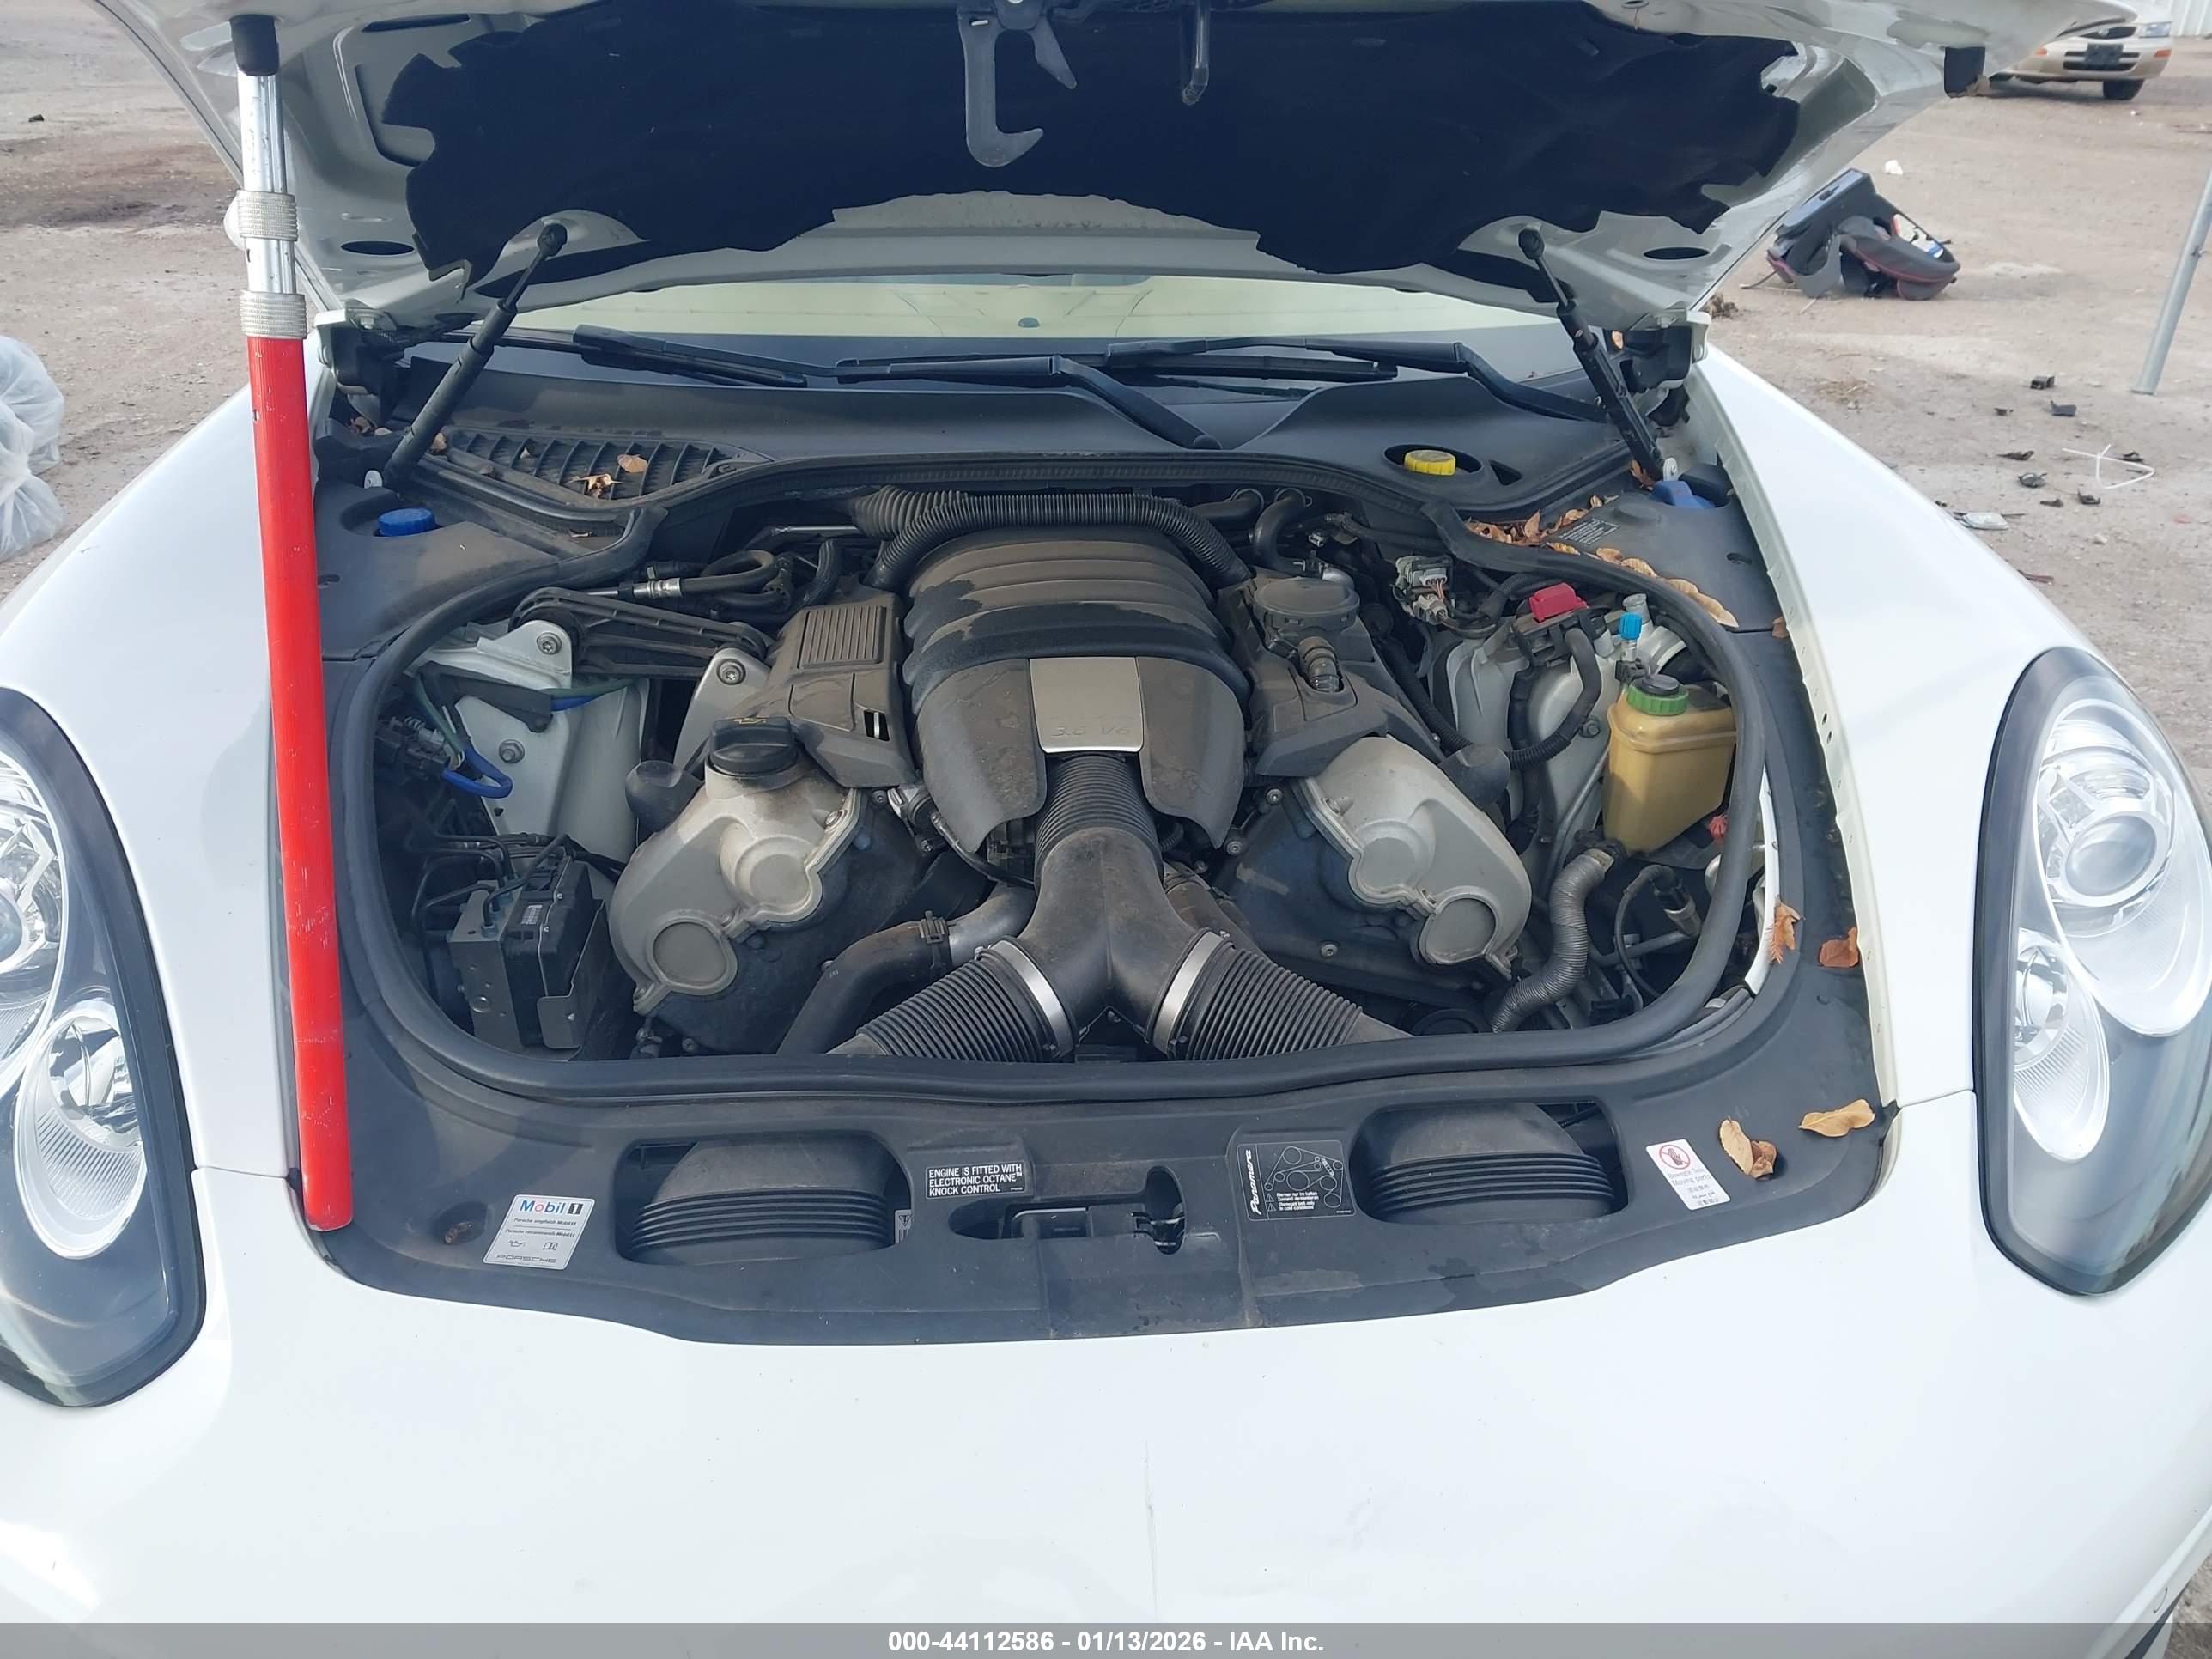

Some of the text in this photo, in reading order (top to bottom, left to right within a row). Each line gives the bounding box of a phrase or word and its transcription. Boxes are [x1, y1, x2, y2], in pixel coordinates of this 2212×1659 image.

[929, 1164, 1022, 1178] ENGINE IS FITTED WITH
[929, 1176, 981, 1188] ELECTRONIC
[1245, 1150, 1262, 1216] Panamera
[929, 1184, 1000, 1196] KNOCK CONTROL
[520, 1200, 566, 1213] Mobil
[497, 1255, 556, 1263] PORSCHE
